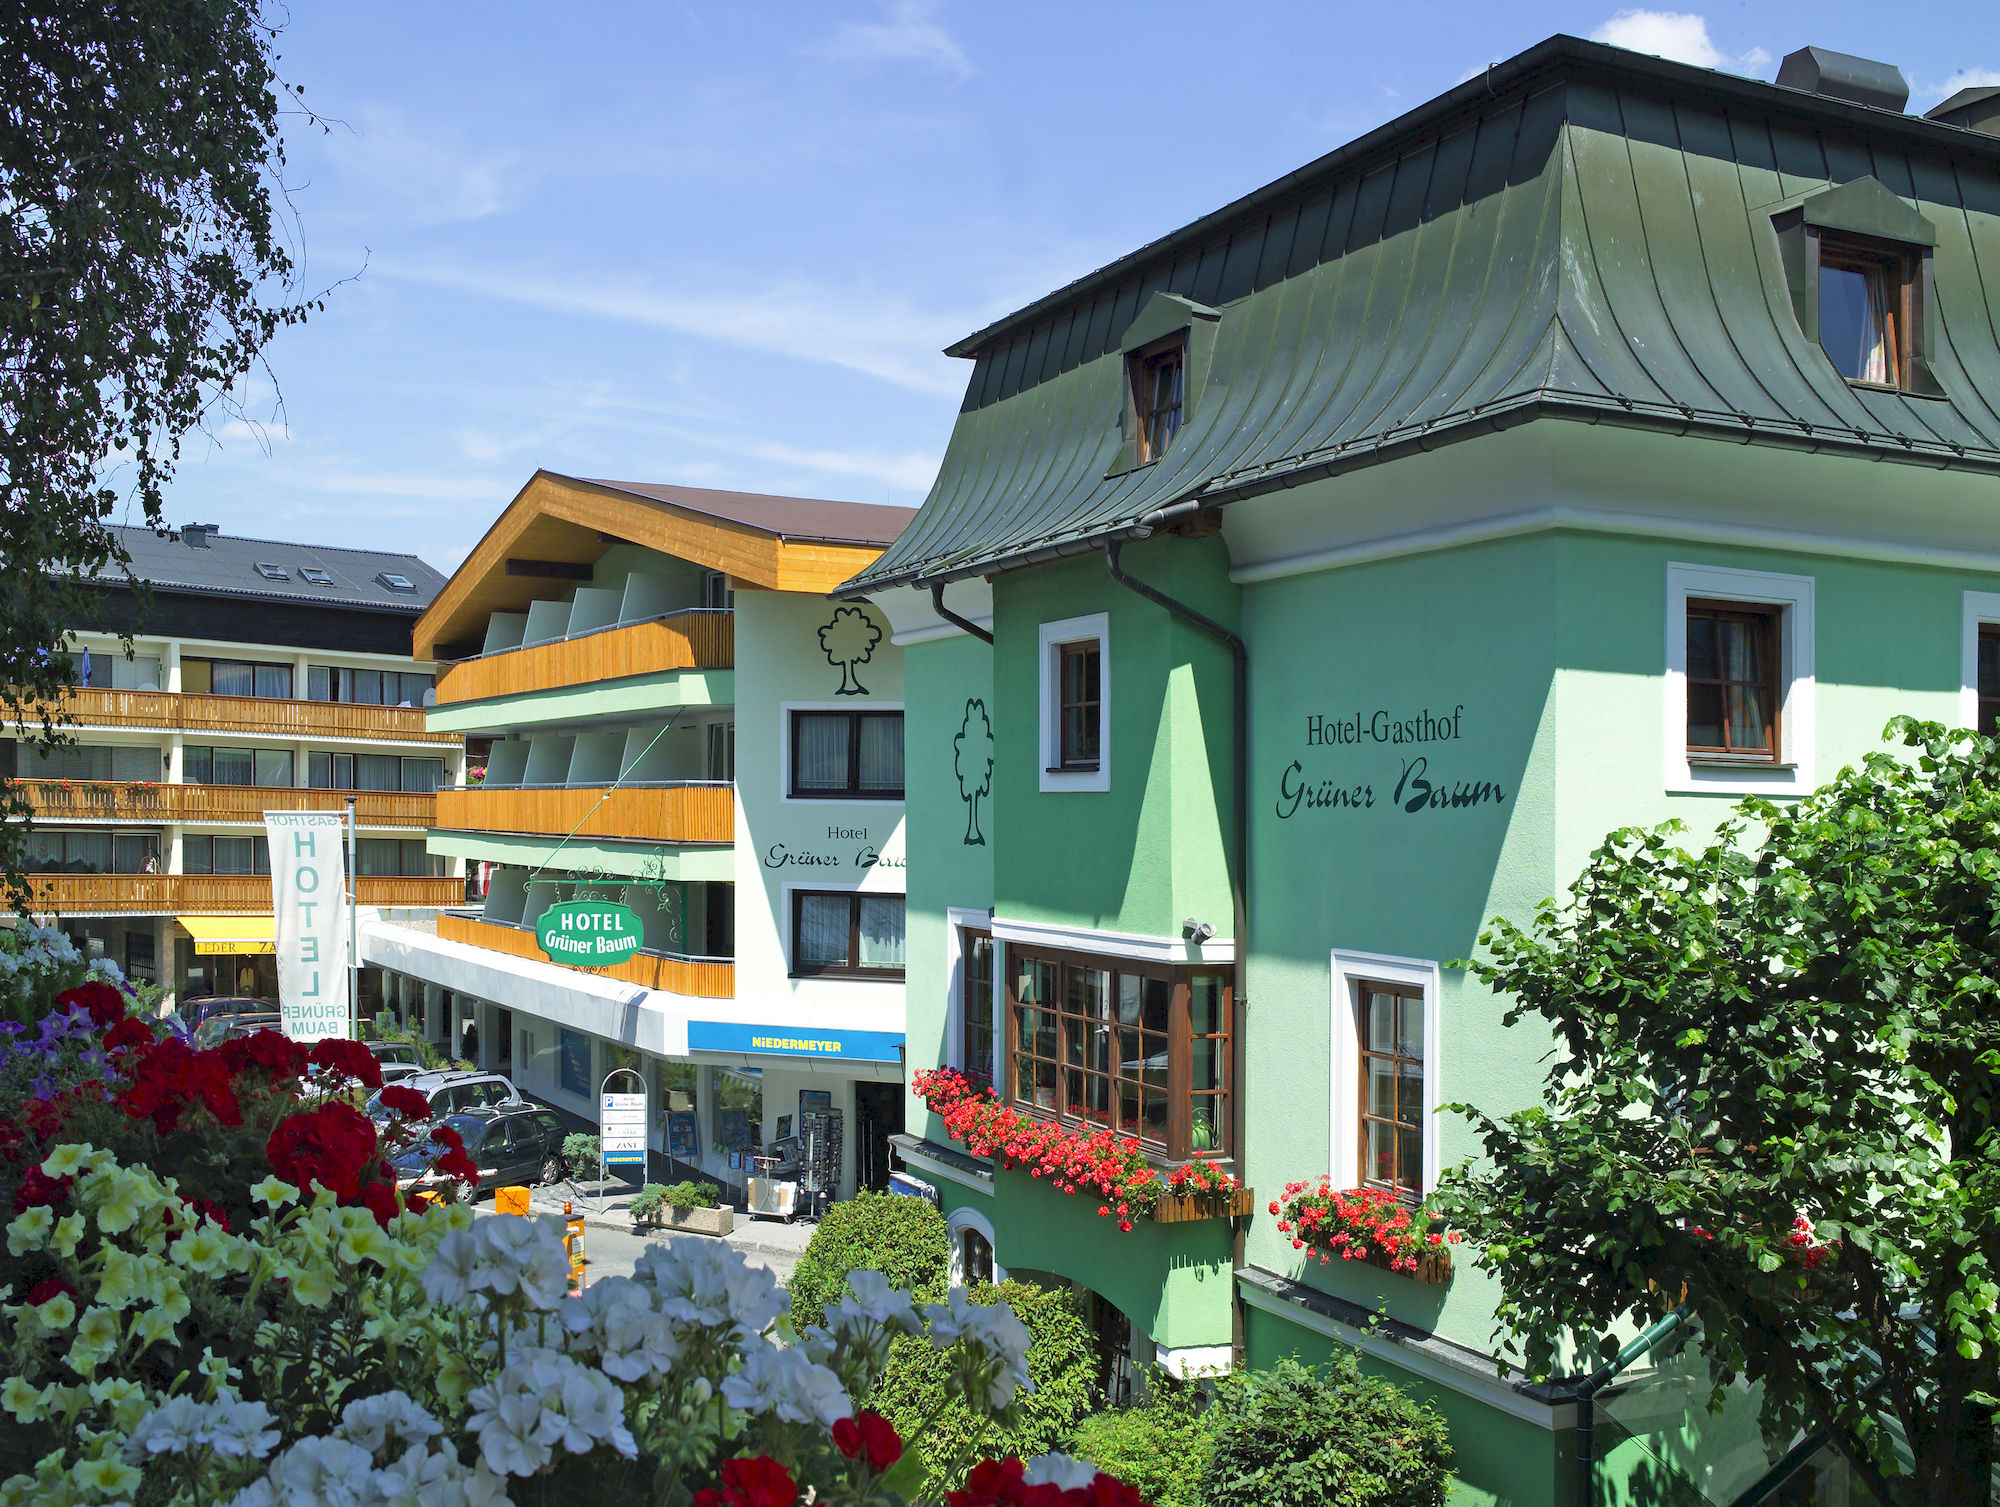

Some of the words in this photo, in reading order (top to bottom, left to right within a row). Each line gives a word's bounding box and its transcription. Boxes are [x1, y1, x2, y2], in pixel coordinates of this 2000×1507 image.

[1306, 705, 1464, 746] Hotel-Gasthof
[1276, 760, 1376, 819] Grüner
[1393, 756, 1506, 813] Baum
[827, 826, 867, 840] Hotel
[764, 843, 840, 869] Grüner
[561, 913, 624, 931] HOTEL
[545, 929, 593, 954] Grüner
[596, 935, 637, 954] Baum
